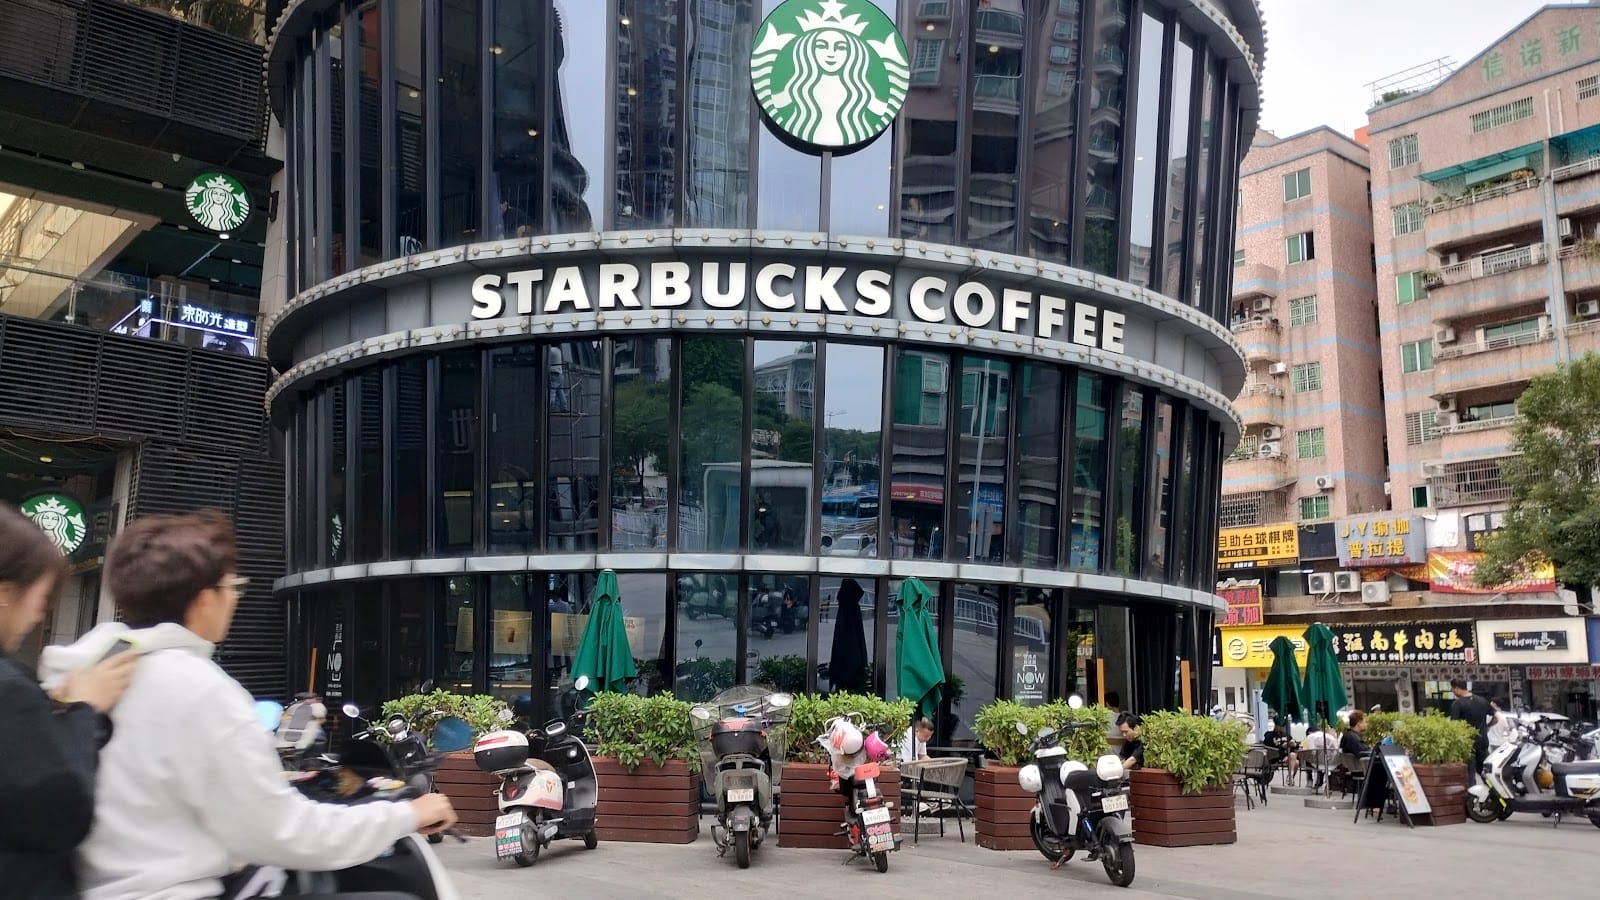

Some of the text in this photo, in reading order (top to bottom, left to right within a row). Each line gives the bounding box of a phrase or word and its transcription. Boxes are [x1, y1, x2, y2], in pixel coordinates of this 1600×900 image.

[1484, 18, 1600, 80] 信诺新
[471, 262, 1126, 353] STARBUCKS COFFEE
[1219, 529, 1294, 547] 自助台球棋牌
[1348, 537, 1405, 558] 普拉提
